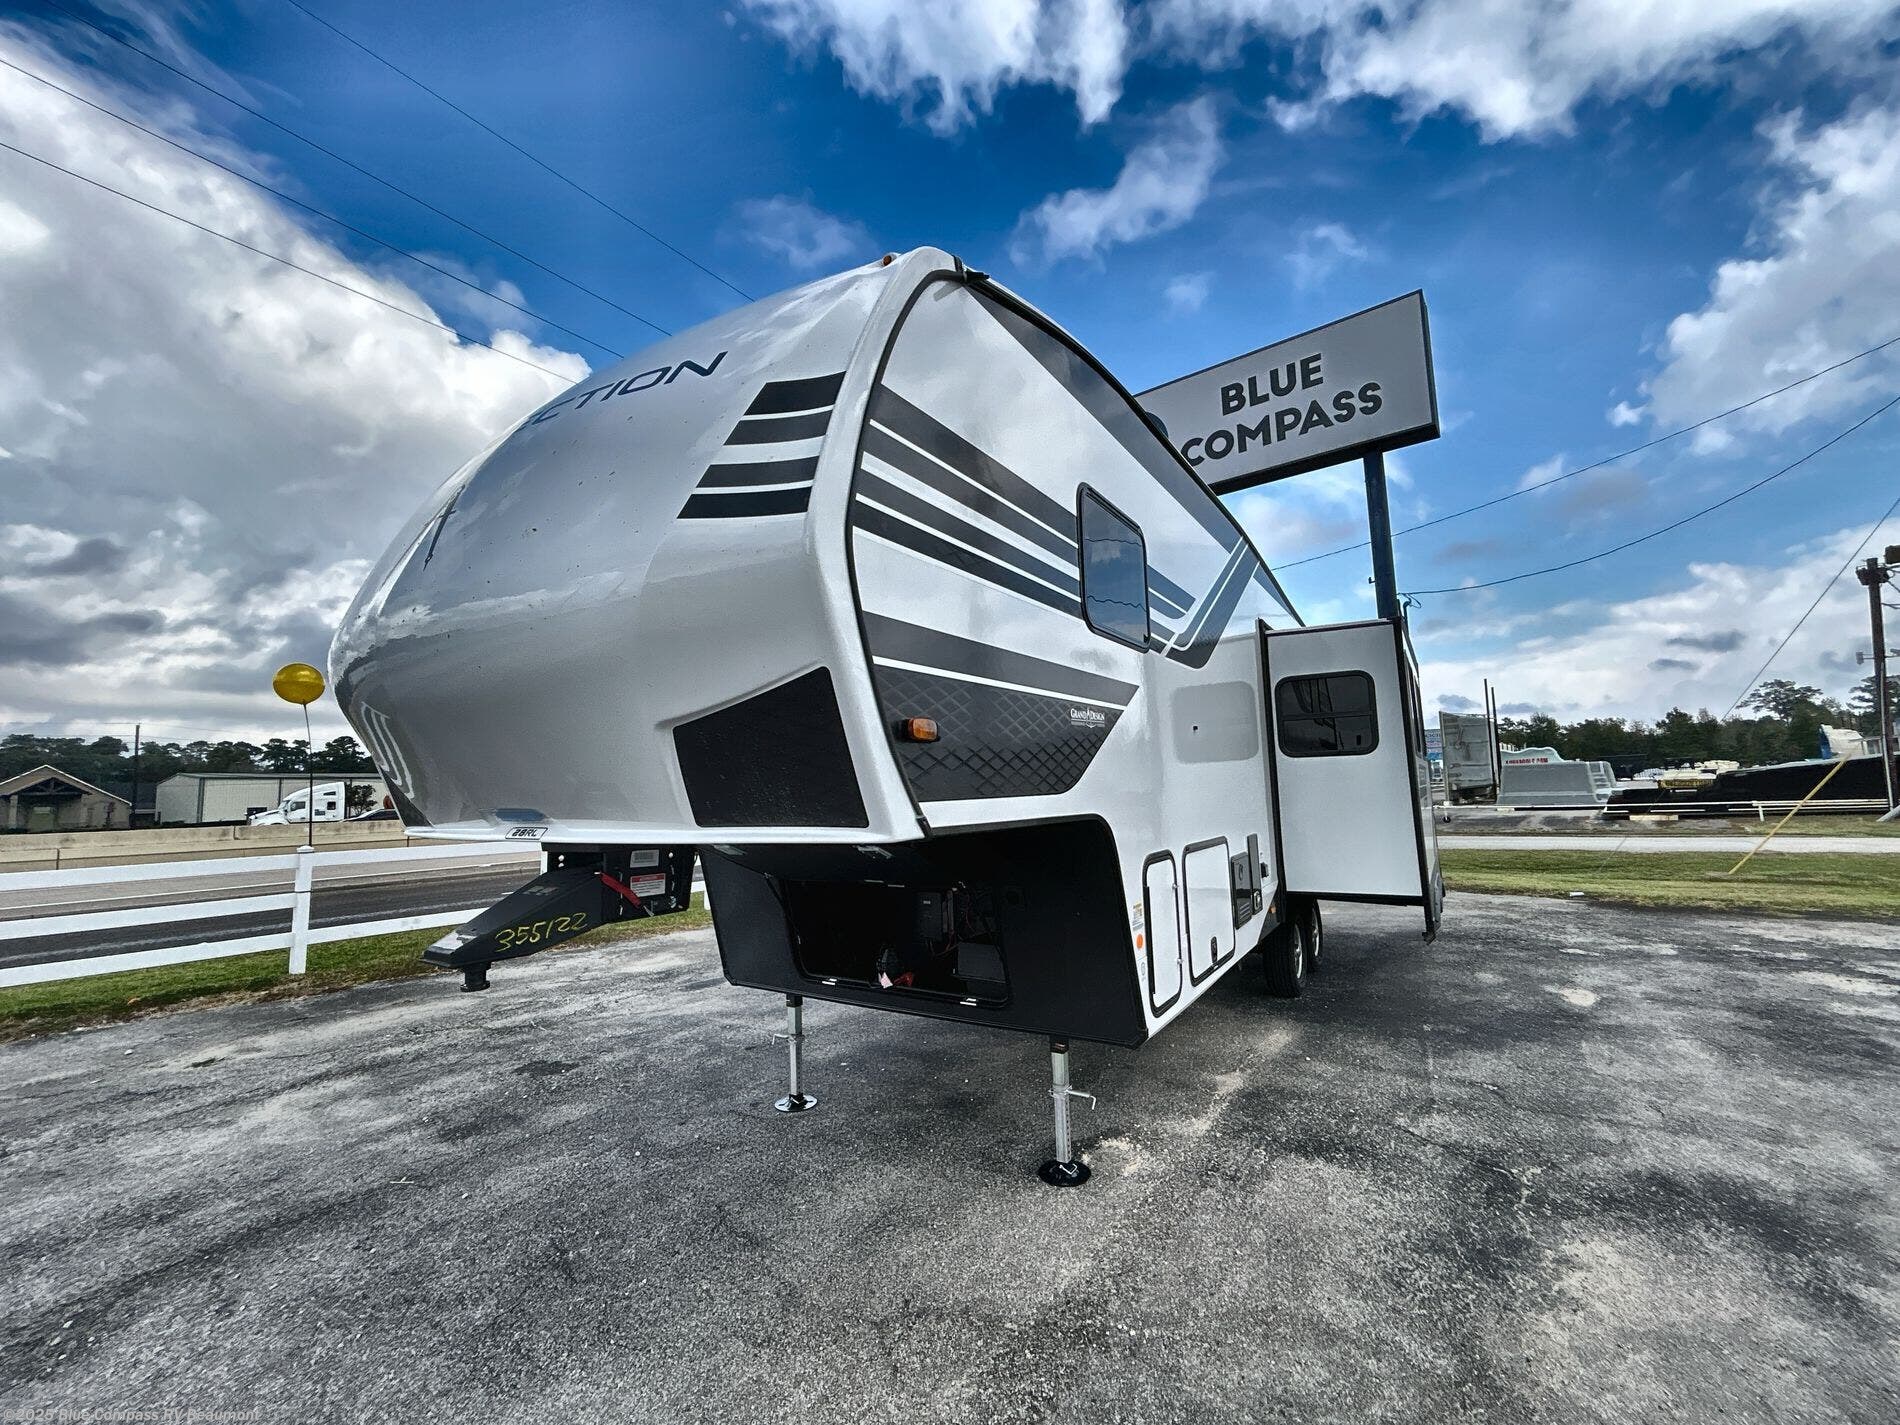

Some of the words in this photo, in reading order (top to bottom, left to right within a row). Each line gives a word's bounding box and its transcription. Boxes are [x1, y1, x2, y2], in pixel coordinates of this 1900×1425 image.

[1221, 353, 1324, 416] BLUE
[1180, 382, 1383, 466] COMPASS
[1070, 708, 1087, 720] GRAND
[1089, 709, 1105, 721] DESIGN
[511, 828, 538, 837] 28RL
